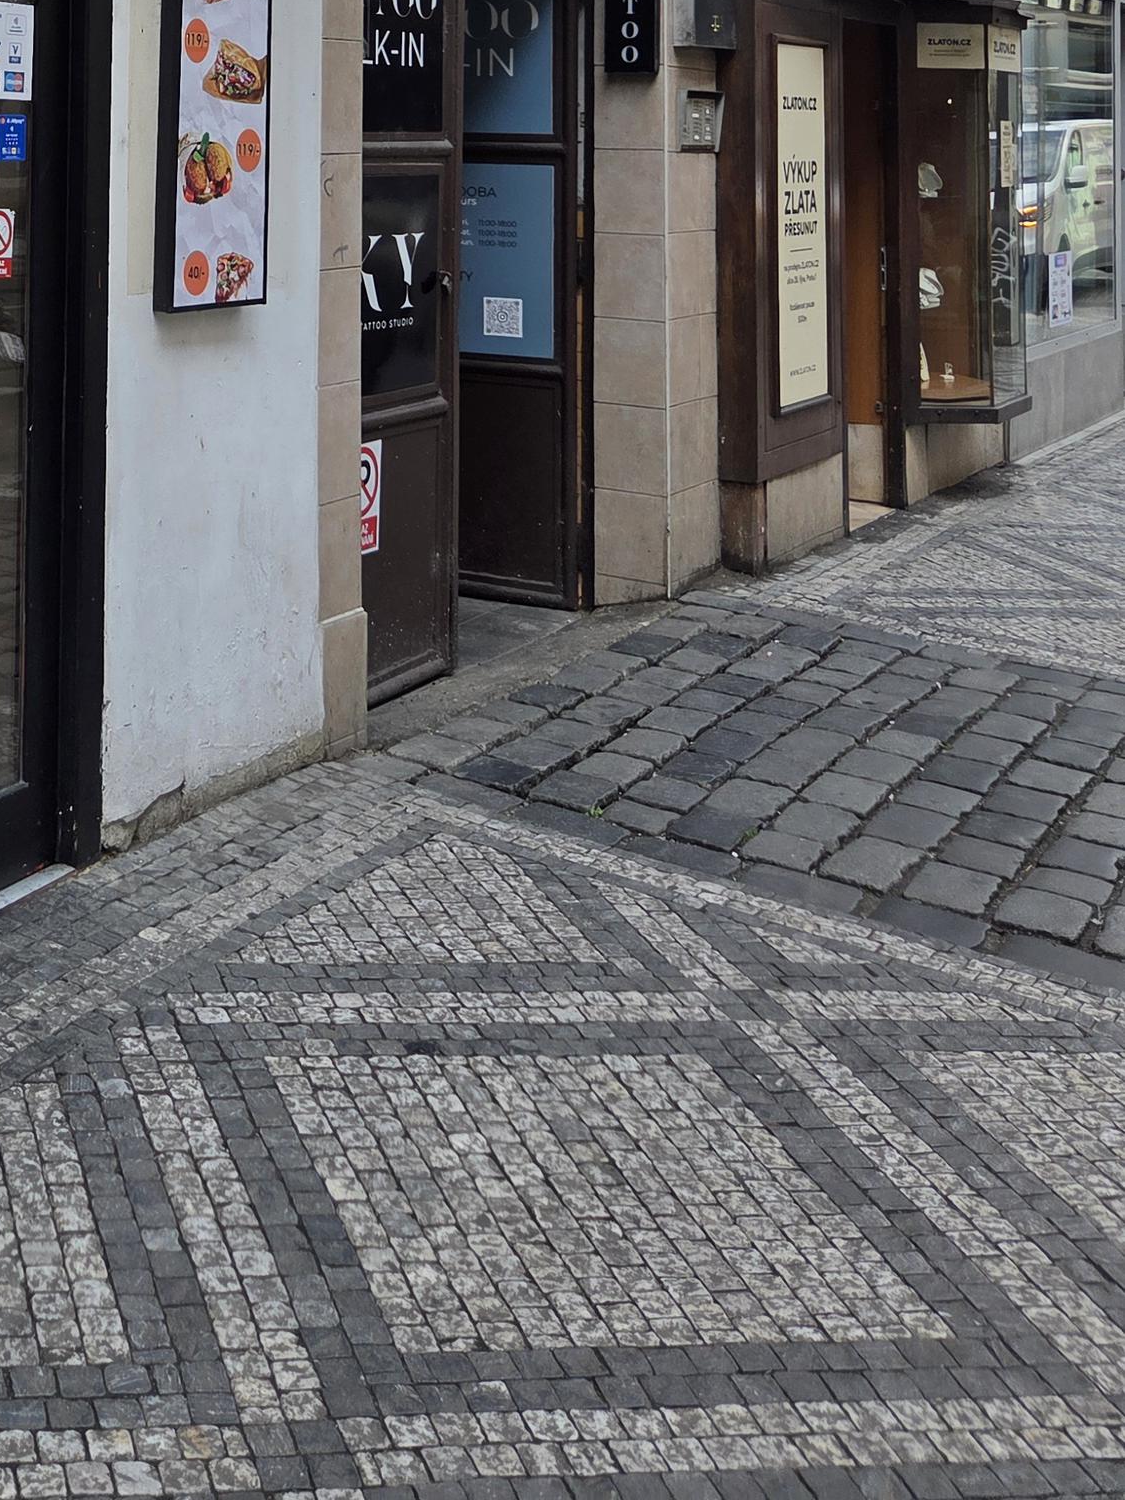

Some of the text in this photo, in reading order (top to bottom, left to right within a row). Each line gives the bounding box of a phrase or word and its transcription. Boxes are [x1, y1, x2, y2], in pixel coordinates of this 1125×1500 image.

[363, 29, 424, 67] K-IN
[928, 38, 971, 46] ZLATON.CZ
[783, 96, 817, 111] ZLATON.CZ
[783, 154, 817, 184] VÝKUP
[785, 190, 817, 215] ZLATA
[785, 218, 817, 236] PŘESUNUT
[389, 317, 414, 328] STUDIO
